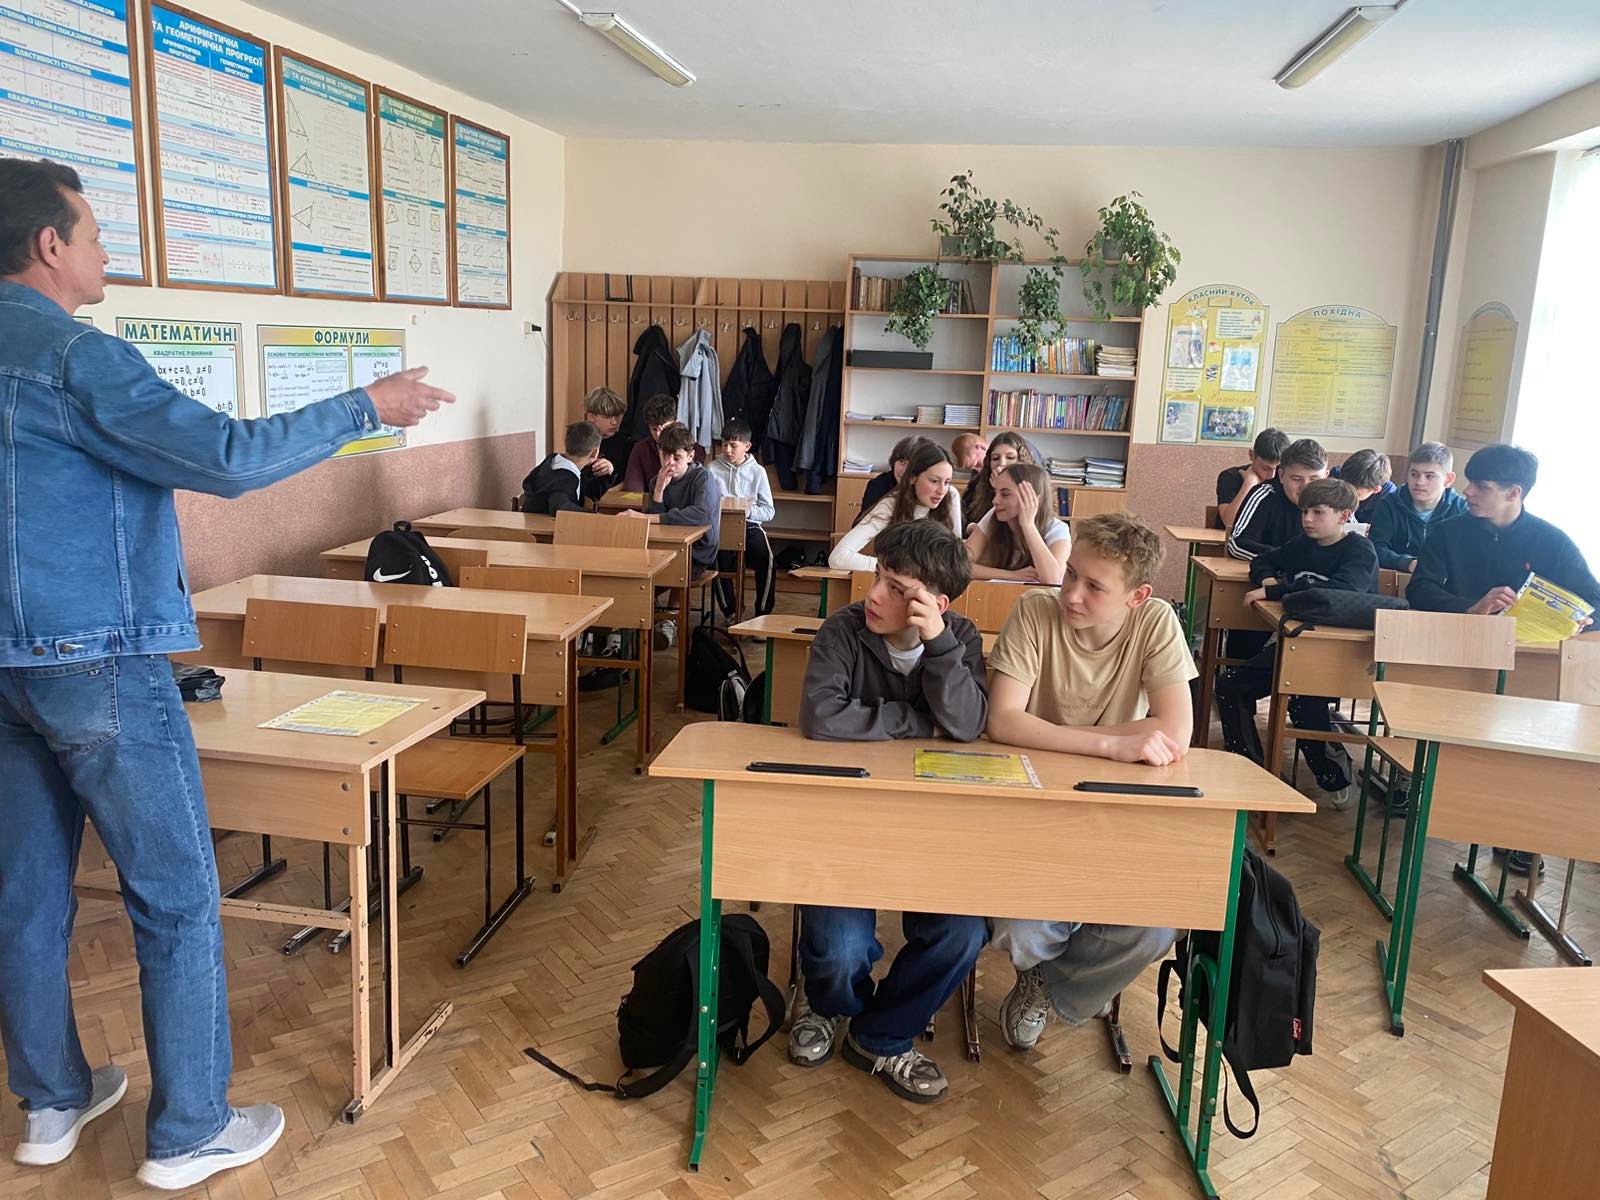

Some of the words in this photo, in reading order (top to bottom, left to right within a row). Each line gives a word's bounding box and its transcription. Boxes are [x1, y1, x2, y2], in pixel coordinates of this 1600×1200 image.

[178, 20, 239, 49] АРИФМЕТИЧНА
[152, 20, 164, 32] ТА
[165, 25, 224, 54] ГЕОМЕТРИЧНА
[225, 47, 263, 67] ПРОГРЕСІЇ
[1229, 290, 1256, 306] КУТОК
[1313, 308, 1361, 318] ПОХІДНА
[125, 323, 237, 342] МАТЕМАТИЧНІ
[314, 331, 369, 344] ФОРМУЛИ
